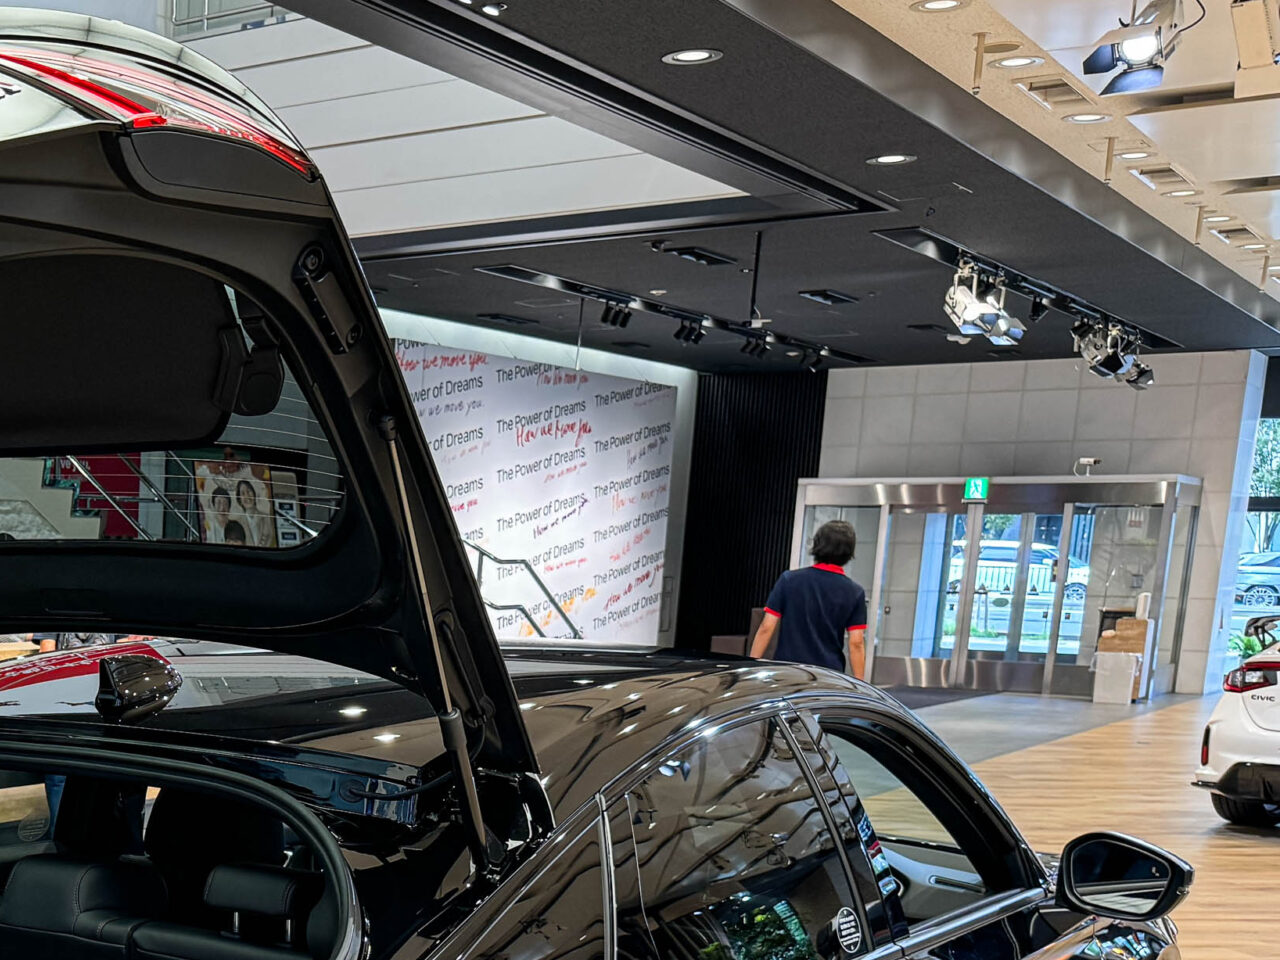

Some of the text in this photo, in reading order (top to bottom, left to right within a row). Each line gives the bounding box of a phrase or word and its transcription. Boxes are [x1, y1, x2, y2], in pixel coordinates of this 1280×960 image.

[422, 356, 438, 370] we
[439, 354, 466, 369] move
[496, 369, 513, 383] The
[515, 363, 541, 380] Power
[412, 376, 483, 403] wer of Dreams
[595, 394, 609, 407] The
[610, 388, 634, 403] Power
[635, 384, 643, 398] of
[496, 400, 586, 434] The Power of Dreams
[433, 427, 484, 451] of Dreams
[594, 421, 671, 453] The Power of Dreams
[497, 446, 586, 484] The Power of Dreams
[594, 465, 670, 499] The Power of Dreams
[447, 477, 483, 498] Dreams
[497, 493, 585, 532] The Power of Dreams
[593, 507, 669, 543] The Power of Dreams
[497, 565, 513, 580] The
[543, 549, 552, 563] of
[553, 538, 584, 558] Dreams
[593, 550, 664, 586] The Power of Dream
[497, 614, 513, 629] The
[554, 585, 584, 603] Dreams
[593, 617, 608, 630] The
[607, 608, 631, 626] Power
[632, 602, 640, 616] of
[640, 592, 661, 610] Drea
[1251, 694, 1276, 702] CIVIC
